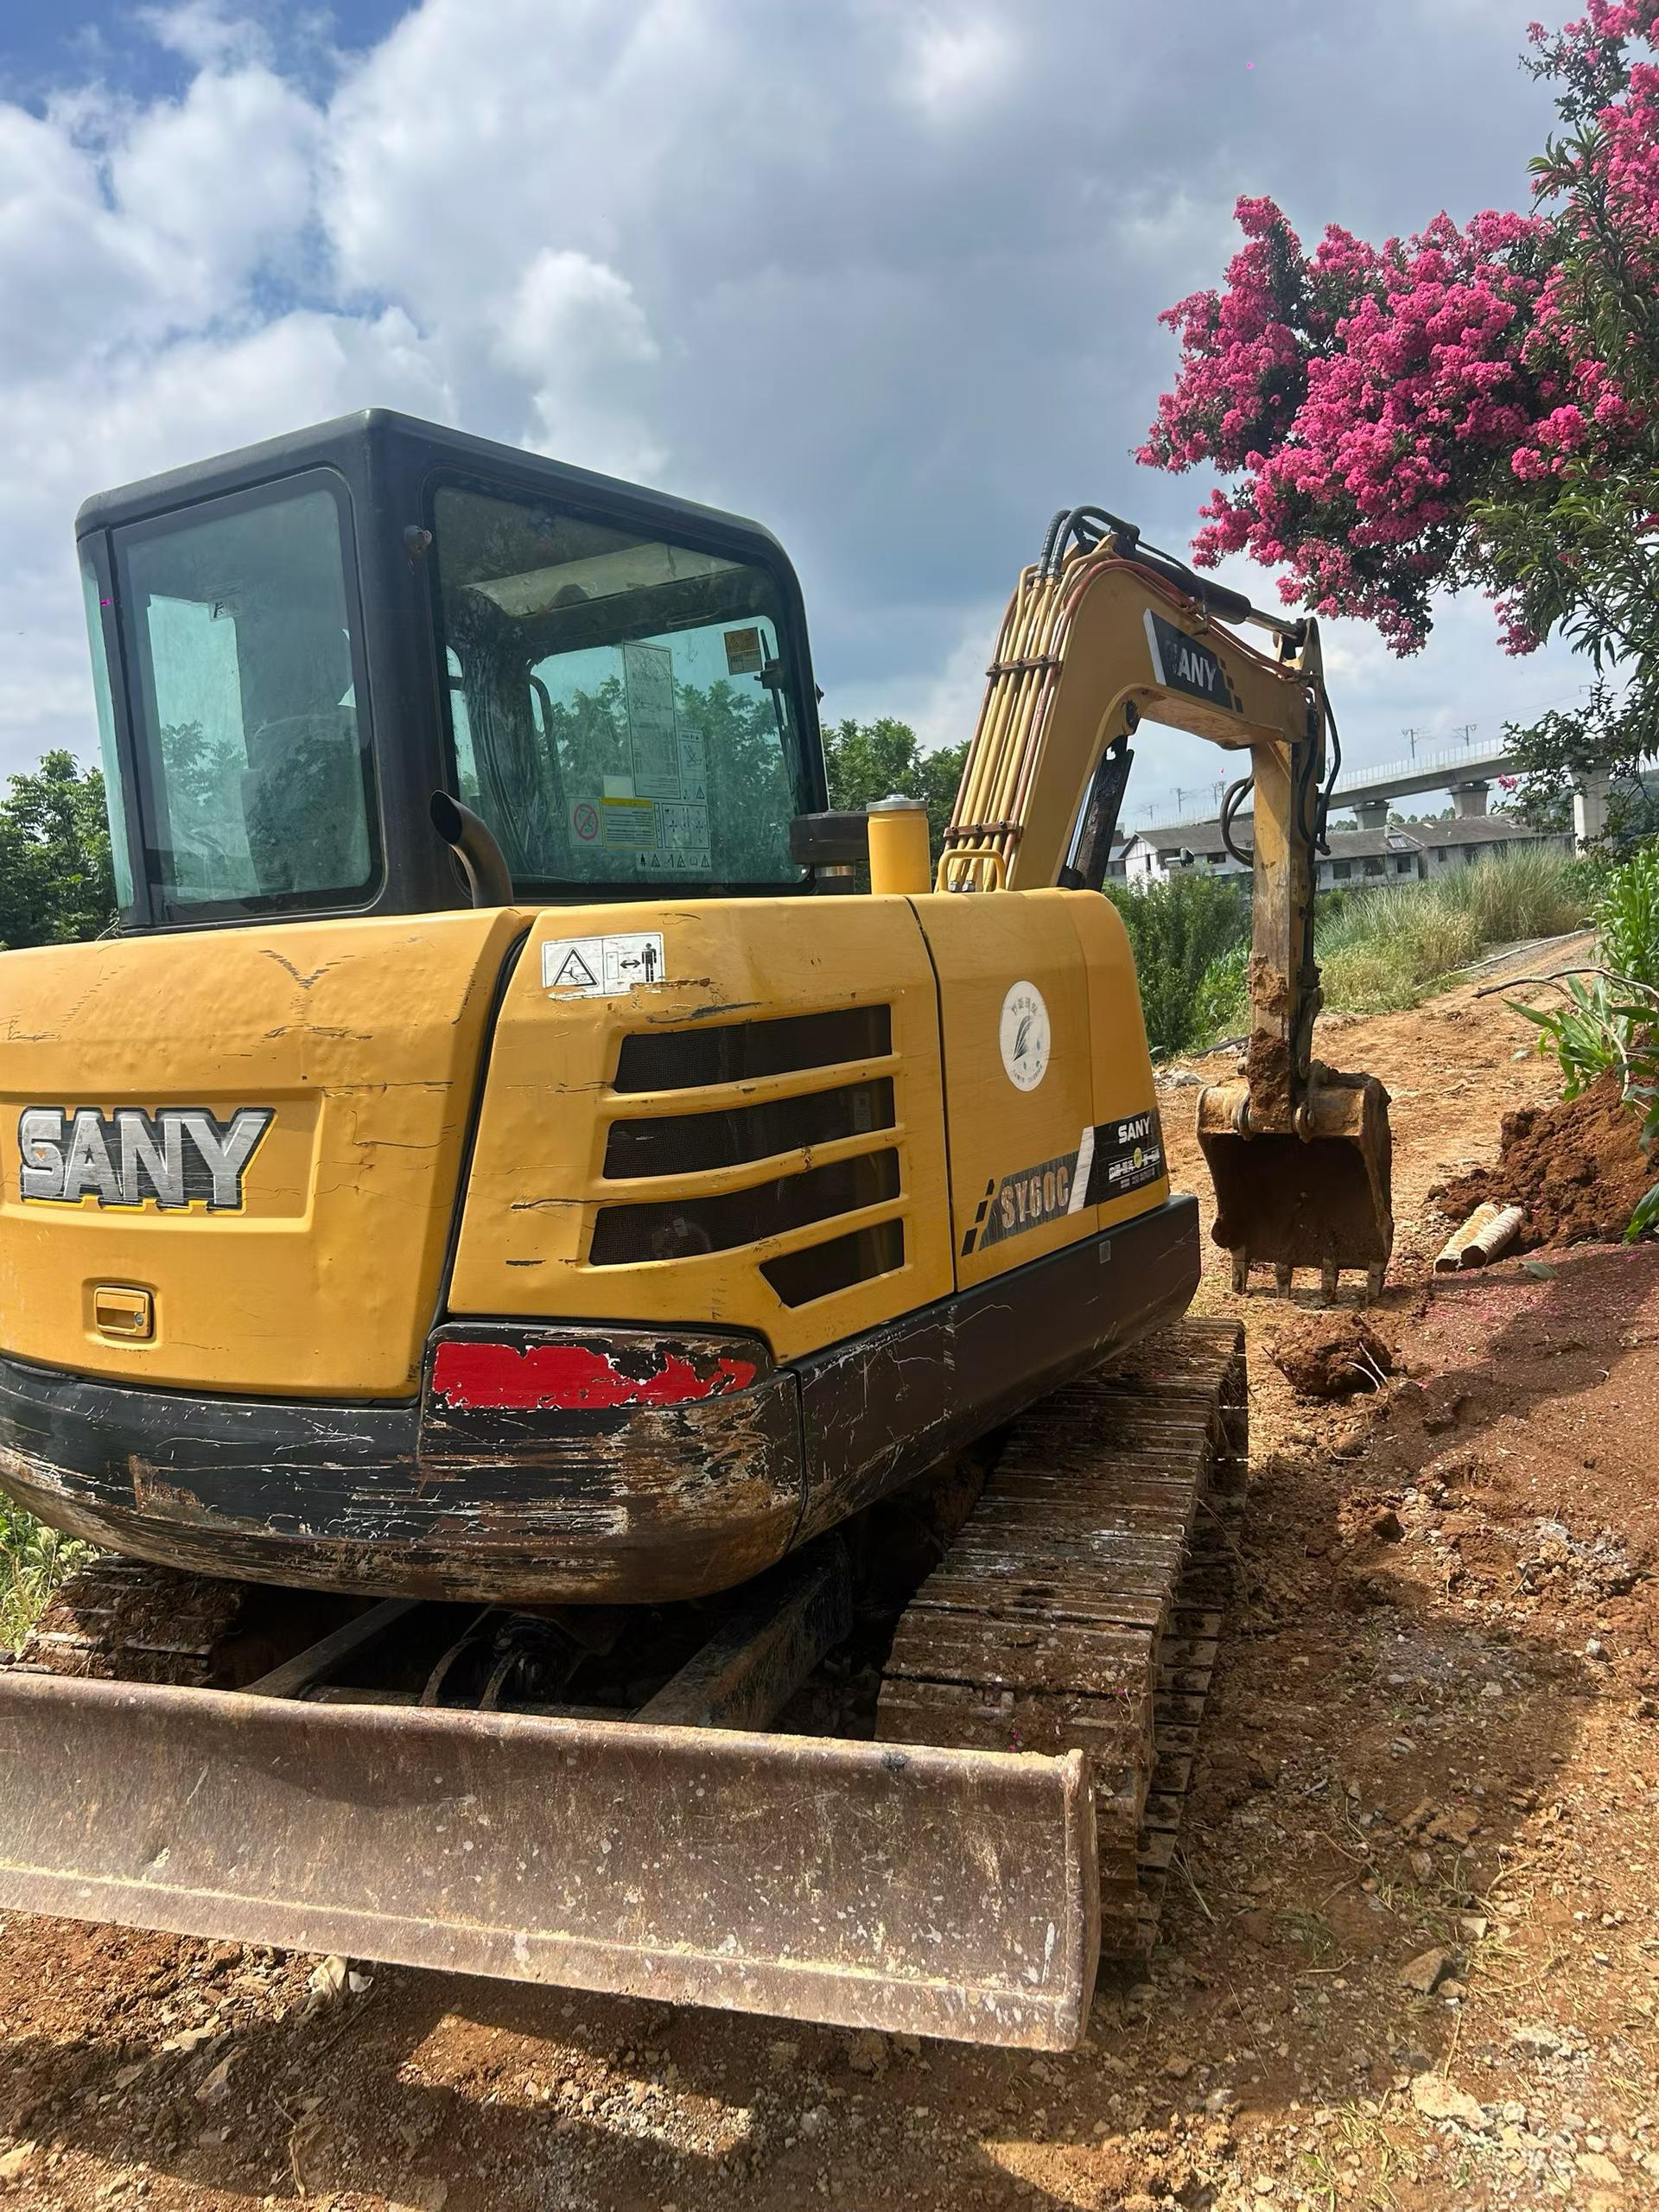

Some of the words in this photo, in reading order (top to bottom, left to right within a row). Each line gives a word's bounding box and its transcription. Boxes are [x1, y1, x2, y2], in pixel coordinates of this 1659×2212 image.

[1163, 640, 1217, 692] ANY
[19, 1108, 275, 1211] SANY
[1118, 1116, 1151, 1145] SANY
[1000, 1166, 1070, 1230] SY60C
